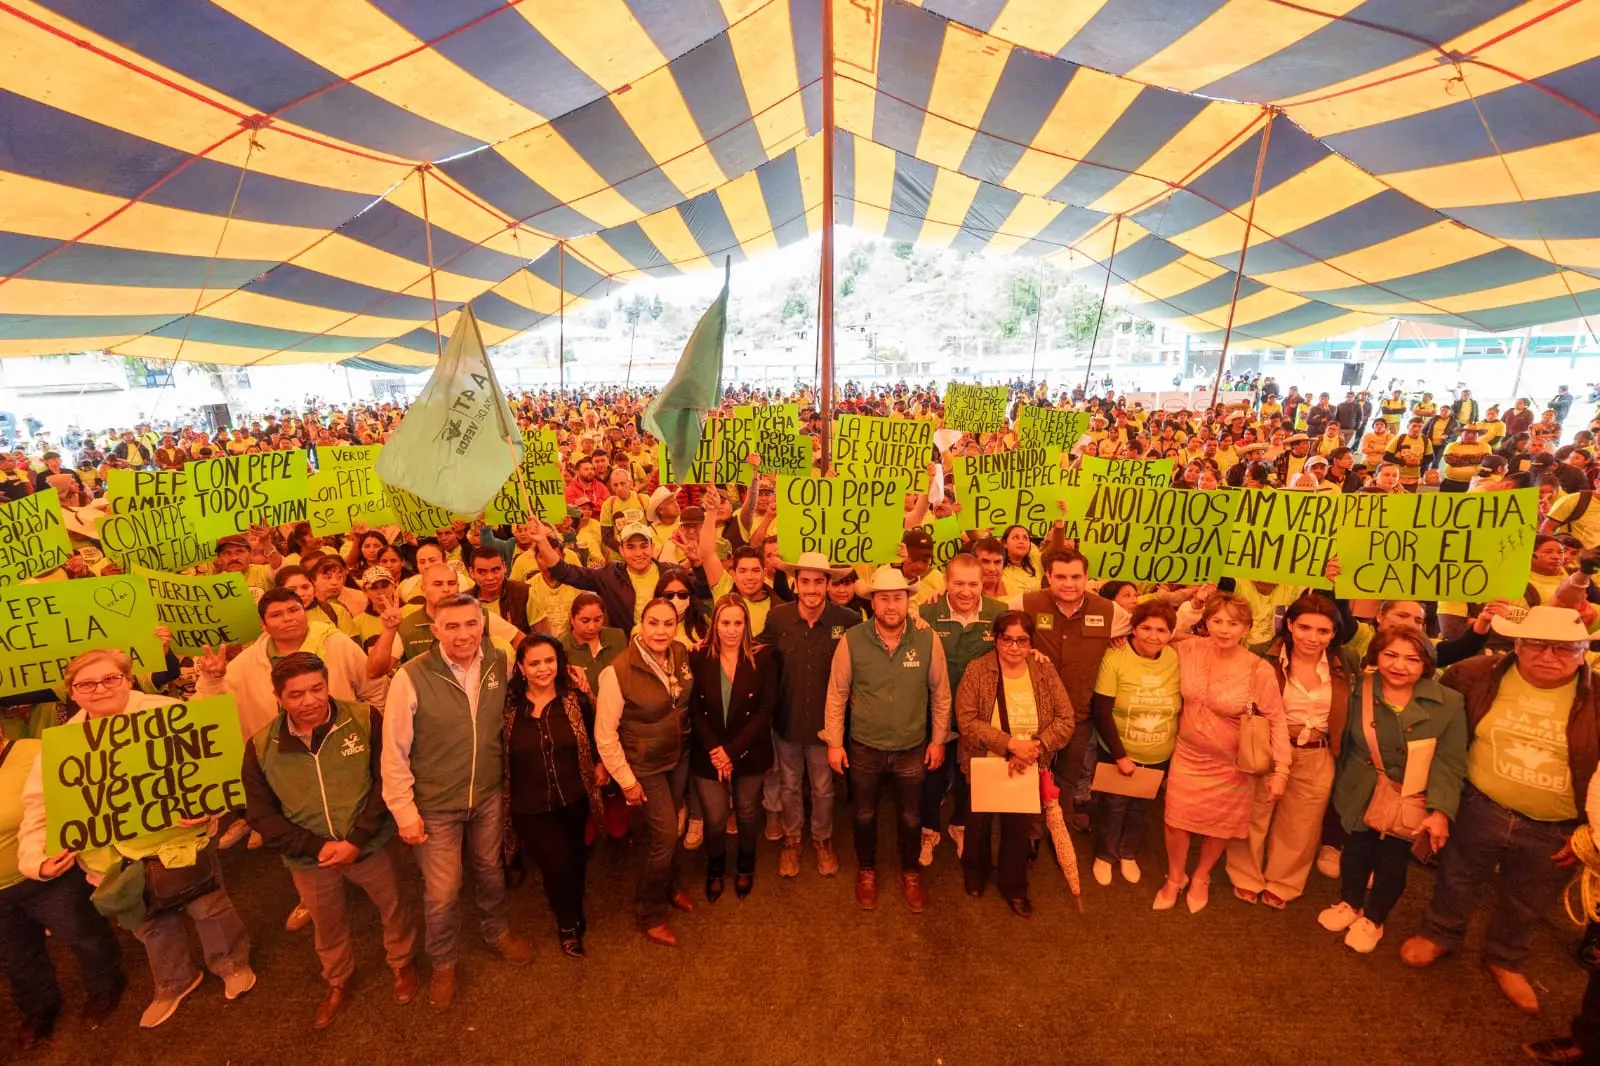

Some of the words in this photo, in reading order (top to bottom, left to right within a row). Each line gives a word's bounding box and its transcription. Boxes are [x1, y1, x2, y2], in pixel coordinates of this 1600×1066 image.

[961, 396, 1005, 411] SULTEPEC
[1025, 406, 1079, 424] SULTEPEC
[758, 416, 795, 433] CHA
[967, 422, 985, 433] CON
[991, 410, 1004, 423] DE
[1033, 418, 1079, 433] FUERTE
[712, 417, 753, 441] PEPE
[839, 416, 861, 438] LA
[869, 420, 931, 445] FUERZA
[1020, 427, 1079, 445] SULTEPEC
[331, 449, 372, 462] VERDE
[694, 440, 750, 463] UTURO
[756, 442, 807, 460] UMPLE
[836, 438, 860, 461] DE
[864, 440, 931, 470] SULTEPEC
[965, 447, 1047, 476] BIENVENIDO
[193, 456, 240, 493] CON
[247, 450, 295, 483] PEPE
[691, 461, 745, 485] VERDE
[968, 475, 981, 494] A
[987, 464, 1057, 492] SULTEPEC
[1059, 468, 1083, 488] PLE
[1106, 459, 1156, 477] PEPE
[134, 471, 188, 496] PEP
[336, 466, 374, 500] PEPE
[112, 495, 186, 515] CAMIN
[193, 481, 269, 517] TODOS
[493, 495, 520, 512] CON
[1234, 488, 1278, 528] AM
[234, 497, 308, 533] CUENTAN
[313, 507, 340, 529] se
[1341, 494, 1389, 529] PEPE
[1412, 494, 1525, 529] LUCHA
[101, 510, 151, 552] CON
[151, 501, 192, 542] PEPE
[1224, 529, 1285, 571] EAM
[1289, 533, 1338, 578] PEP
[1368, 530, 1418, 563] POR
[1439, 529, 1484, 563] EL
[148, 578, 212, 602] FUERZA
[212, 580, 243, 600] DE
[1353, 562, 1489, 597] CAMPO
[6, 595, 62, 620] EPE
[64, 615, 108, 643] LA
[171, 625, 239, 649] VERDE
[1506, 708, 1532, 725] LA
[1129, 729, 1169, 742] VERDE
[58, 747, 130, 788] QUE
[145, 723, 224, 771] UNE
[340, 744, 365, 757] VERDE
[1498, 759, 1565, 789] VERDE
[59, 810, 138, 852] QUE
[141, 778, 247, 833] CRECE
